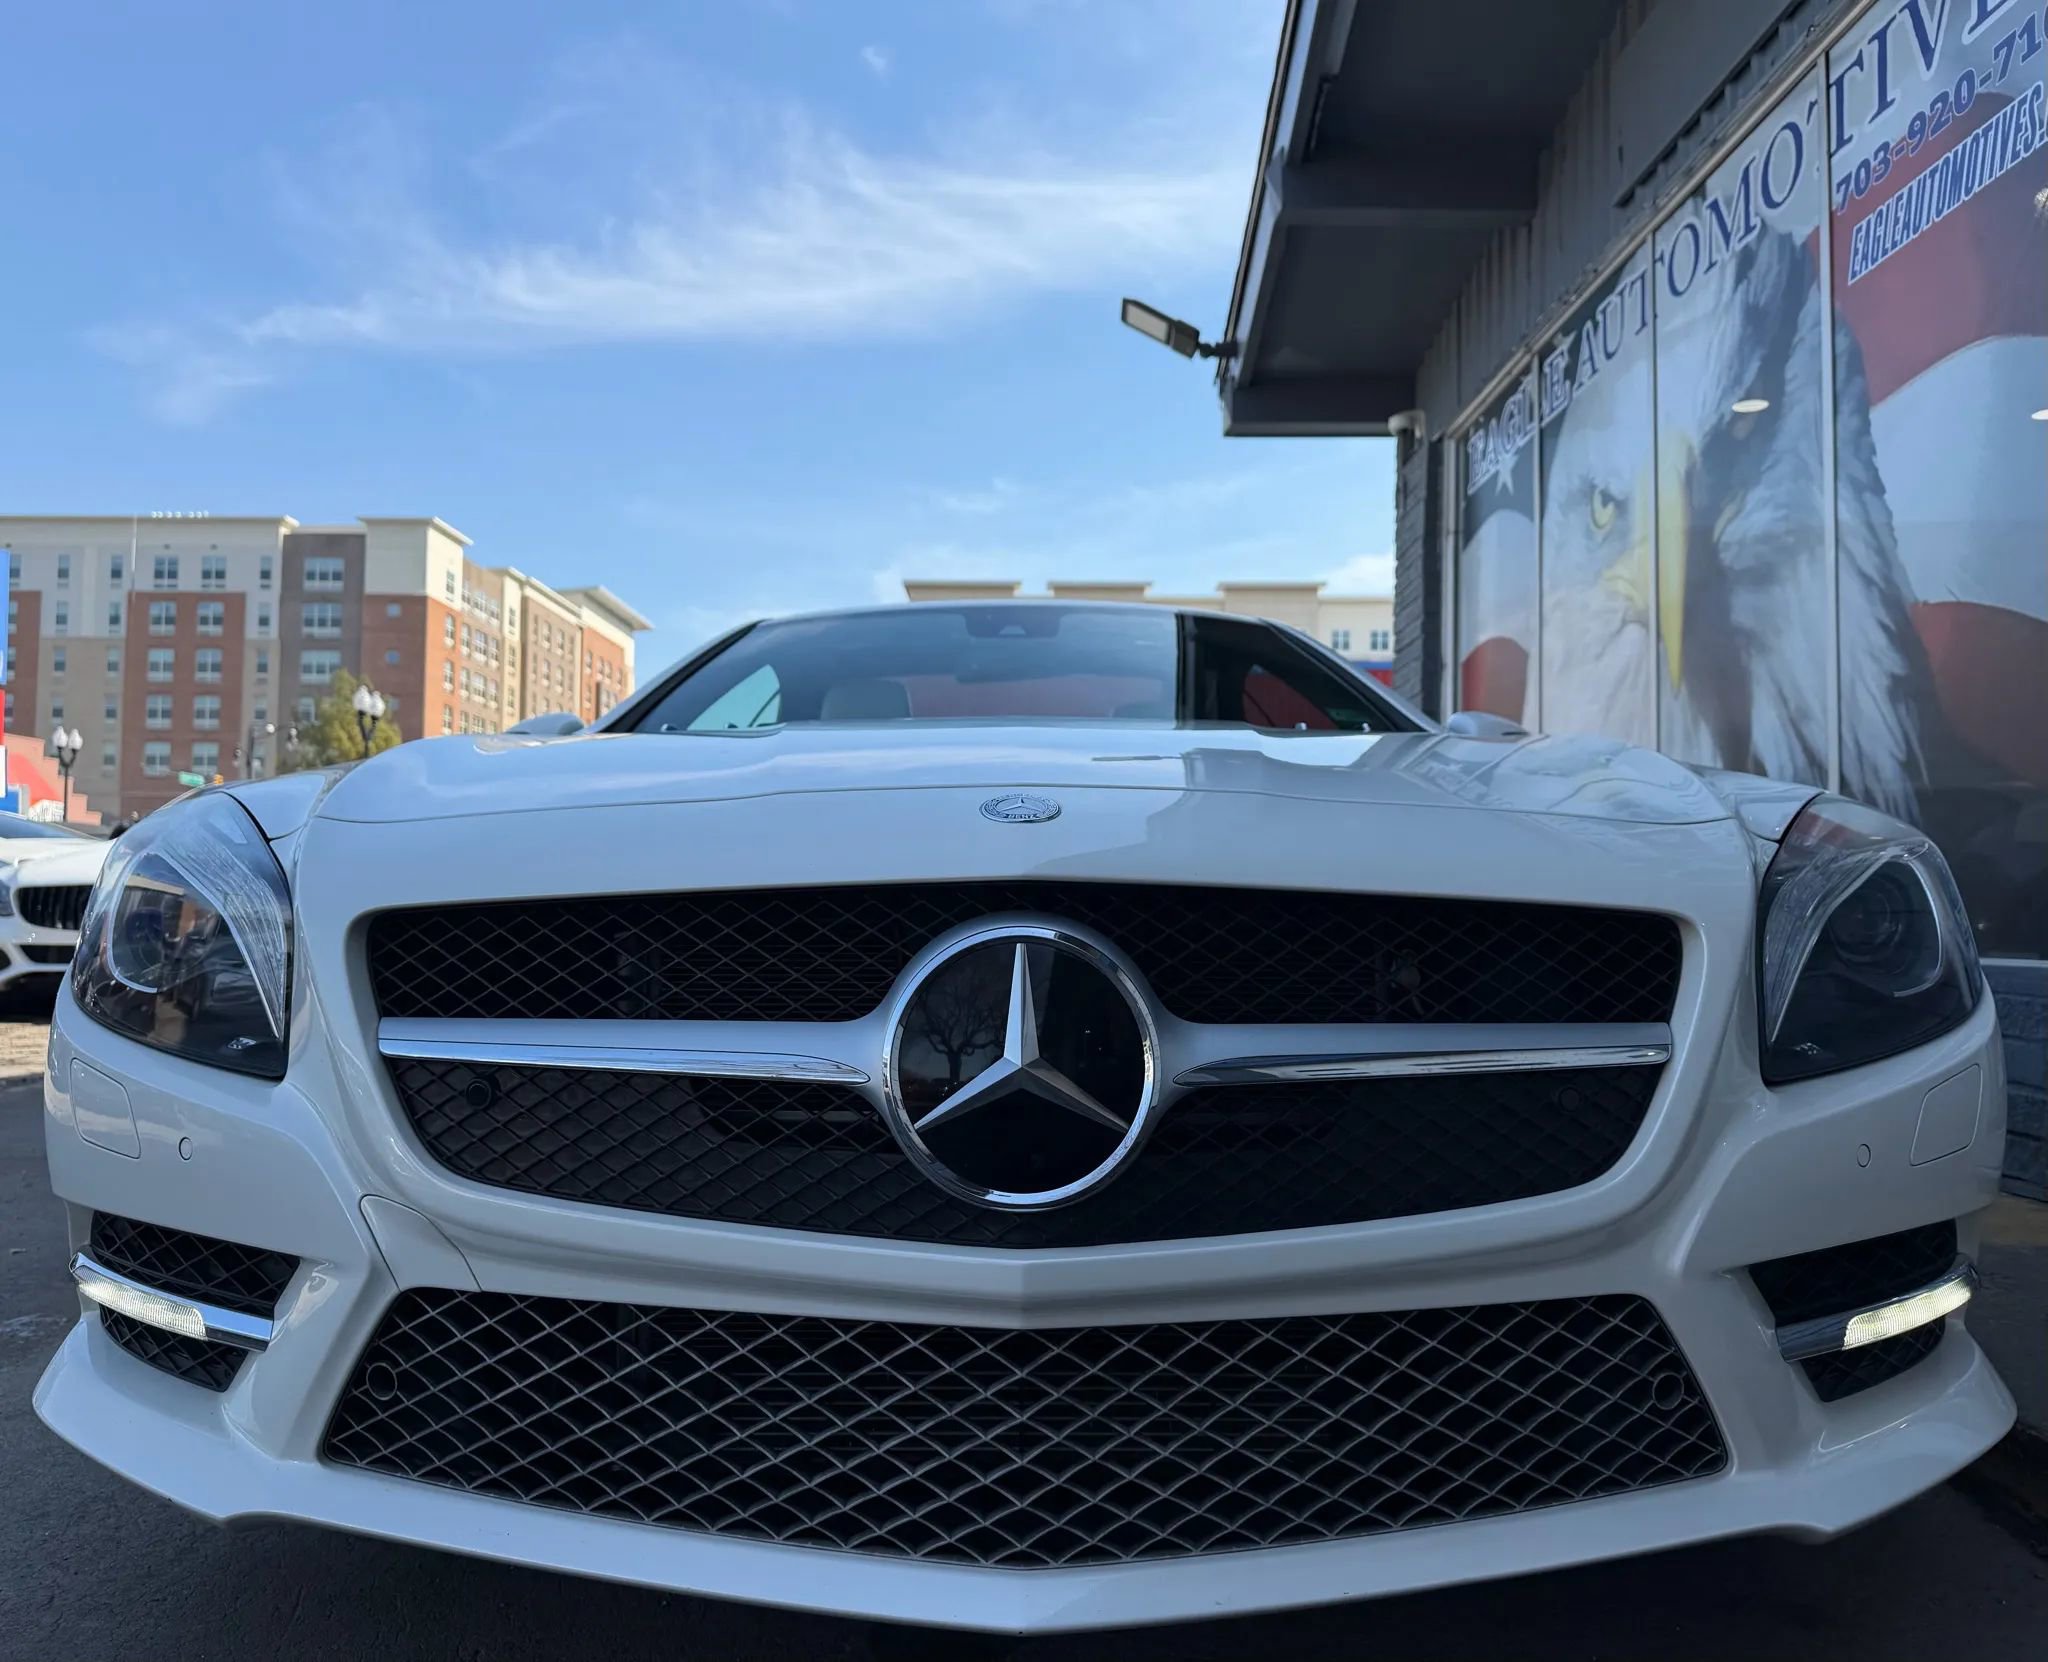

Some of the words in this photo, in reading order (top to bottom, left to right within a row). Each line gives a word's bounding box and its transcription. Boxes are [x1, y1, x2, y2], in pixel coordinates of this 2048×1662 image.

[1836, 4, 2048, 215] 703-920-71
[1848, 81, 2048, 286] EAGLEAUTOMOTIVES.
[1467, 348, 1572, 495] EAGLE
